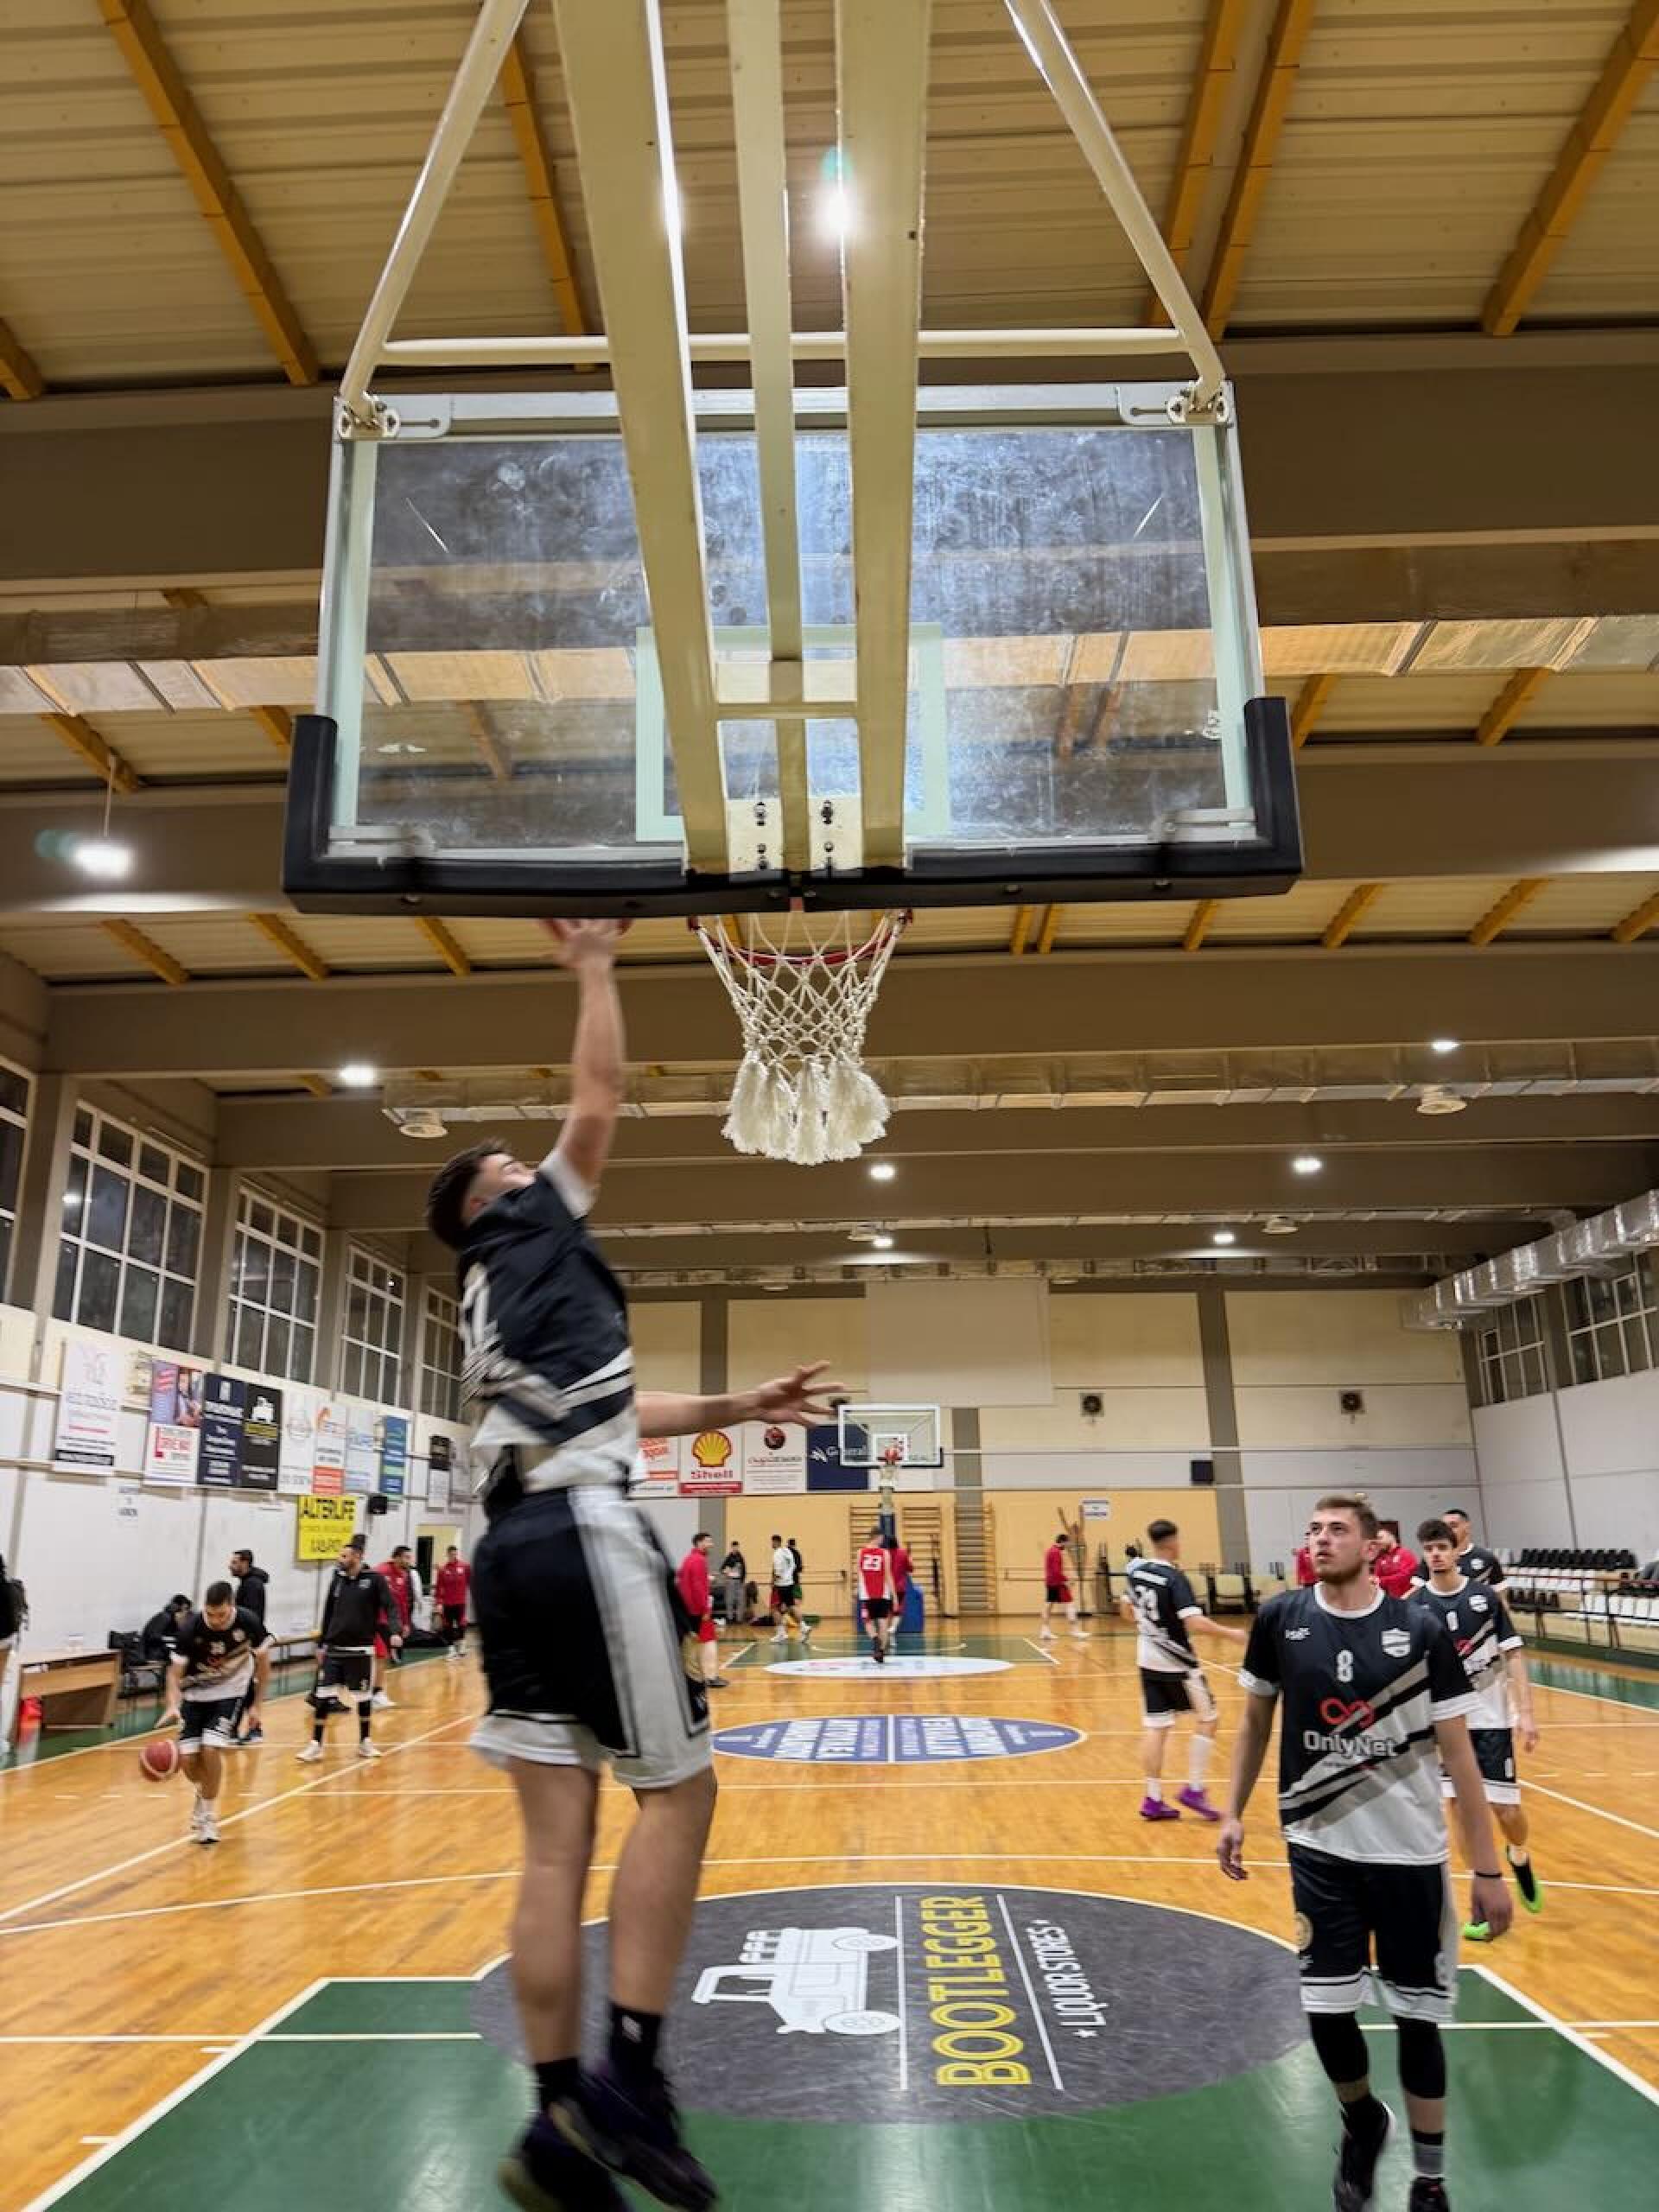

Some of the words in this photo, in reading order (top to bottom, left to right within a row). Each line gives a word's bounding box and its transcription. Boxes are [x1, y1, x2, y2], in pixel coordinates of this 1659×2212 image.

[1336, 1649, 1354, 1682] 8
[1303, 1731, 1397, 1758] OnlyNet
[1026, 1925, 1082, 1971] STORES
[921, 1895, 1032, 2086] BOOTLEGGER
[1042, 1972, 1109, 2027] LIQUOR
